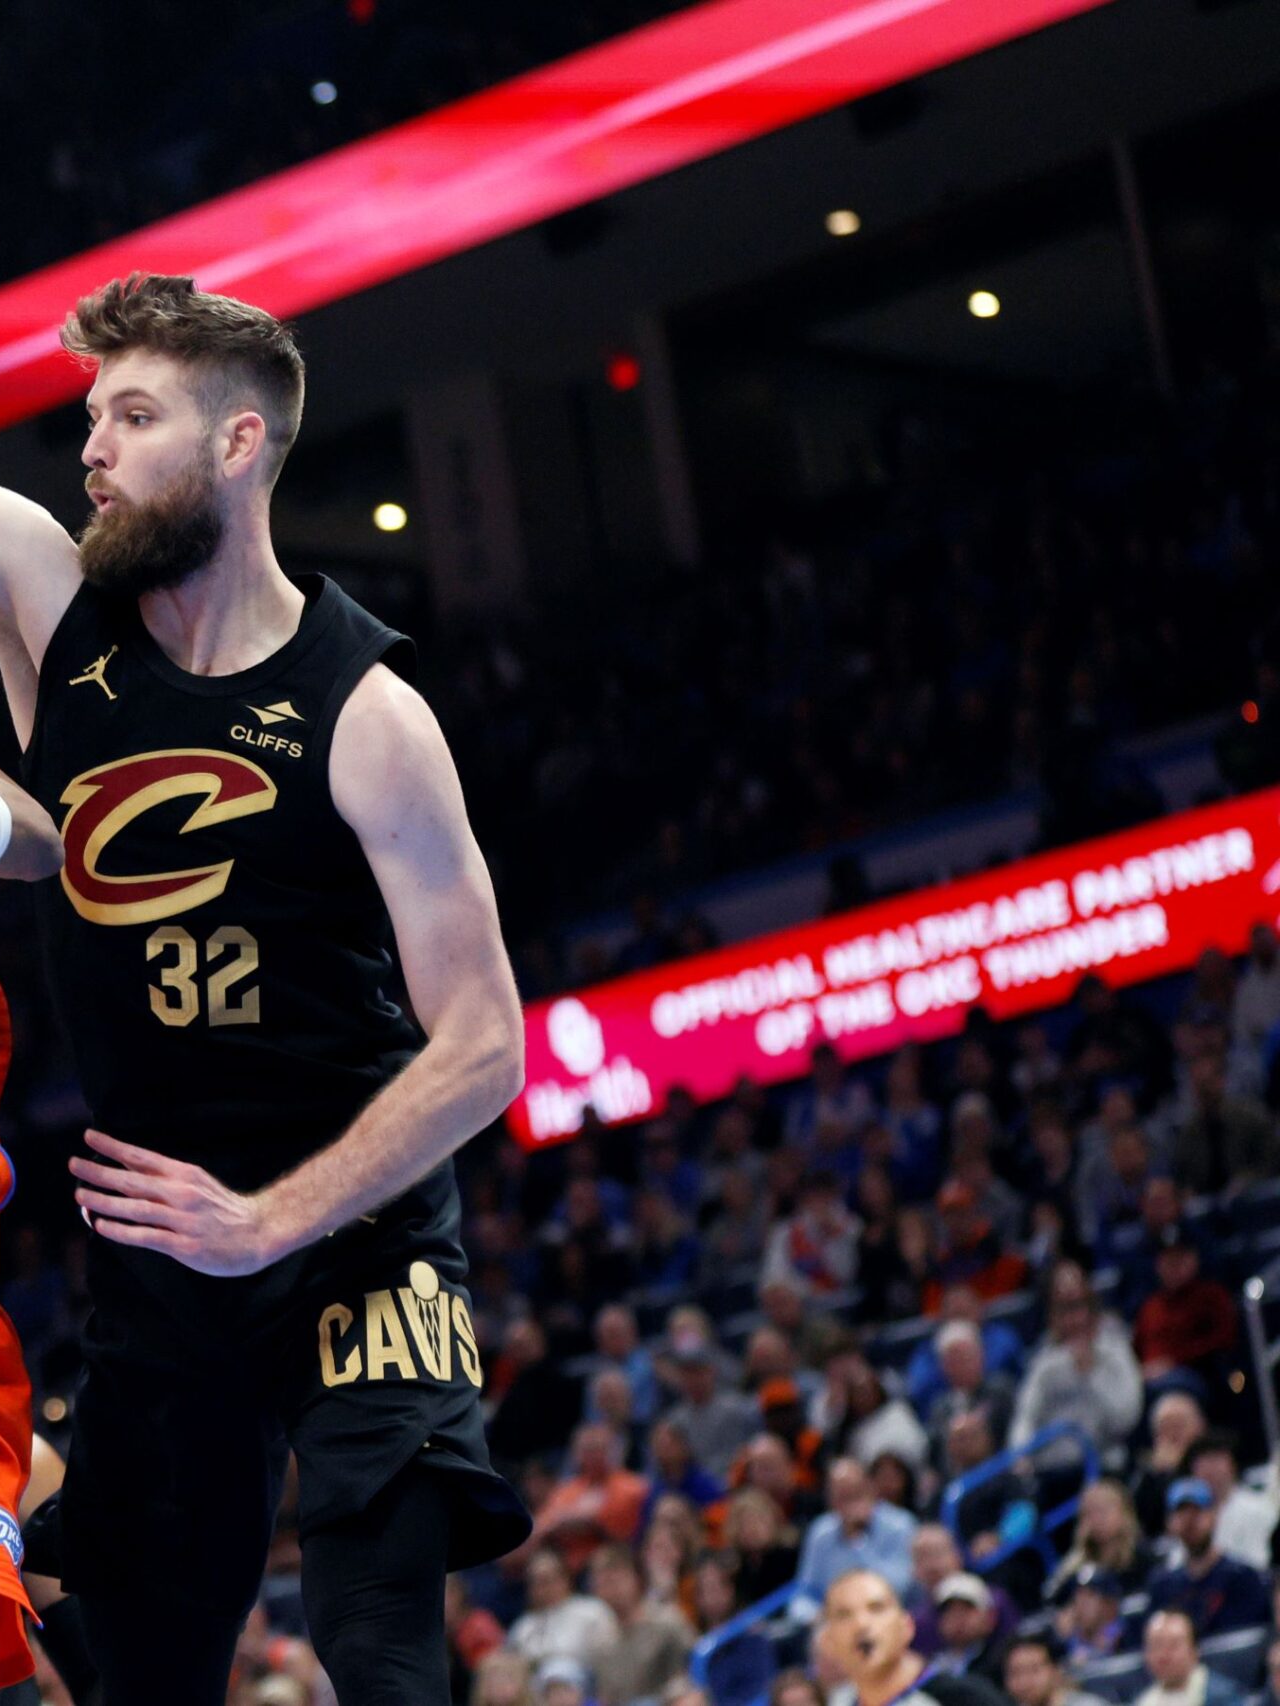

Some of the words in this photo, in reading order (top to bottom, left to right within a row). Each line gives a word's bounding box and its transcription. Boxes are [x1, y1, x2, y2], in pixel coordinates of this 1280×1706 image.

[230, 724, 303, 758] CLIFFS
[146, 926, 260, 1027] 32
[651, 957, 823, 1037] OFFICIAL
[824, 880, 1070, 987] HEALTHCARE
[1073, 829, 1254, 917] PARTNER
[756, 1002, 816, 1055] OF
[816, 981, 894, 1037] THE
[895, 956, 981, 1016] OKC
[984, 904, 1168, 988] THUNDER
[318, 1287, 483, 1389] CAVS
